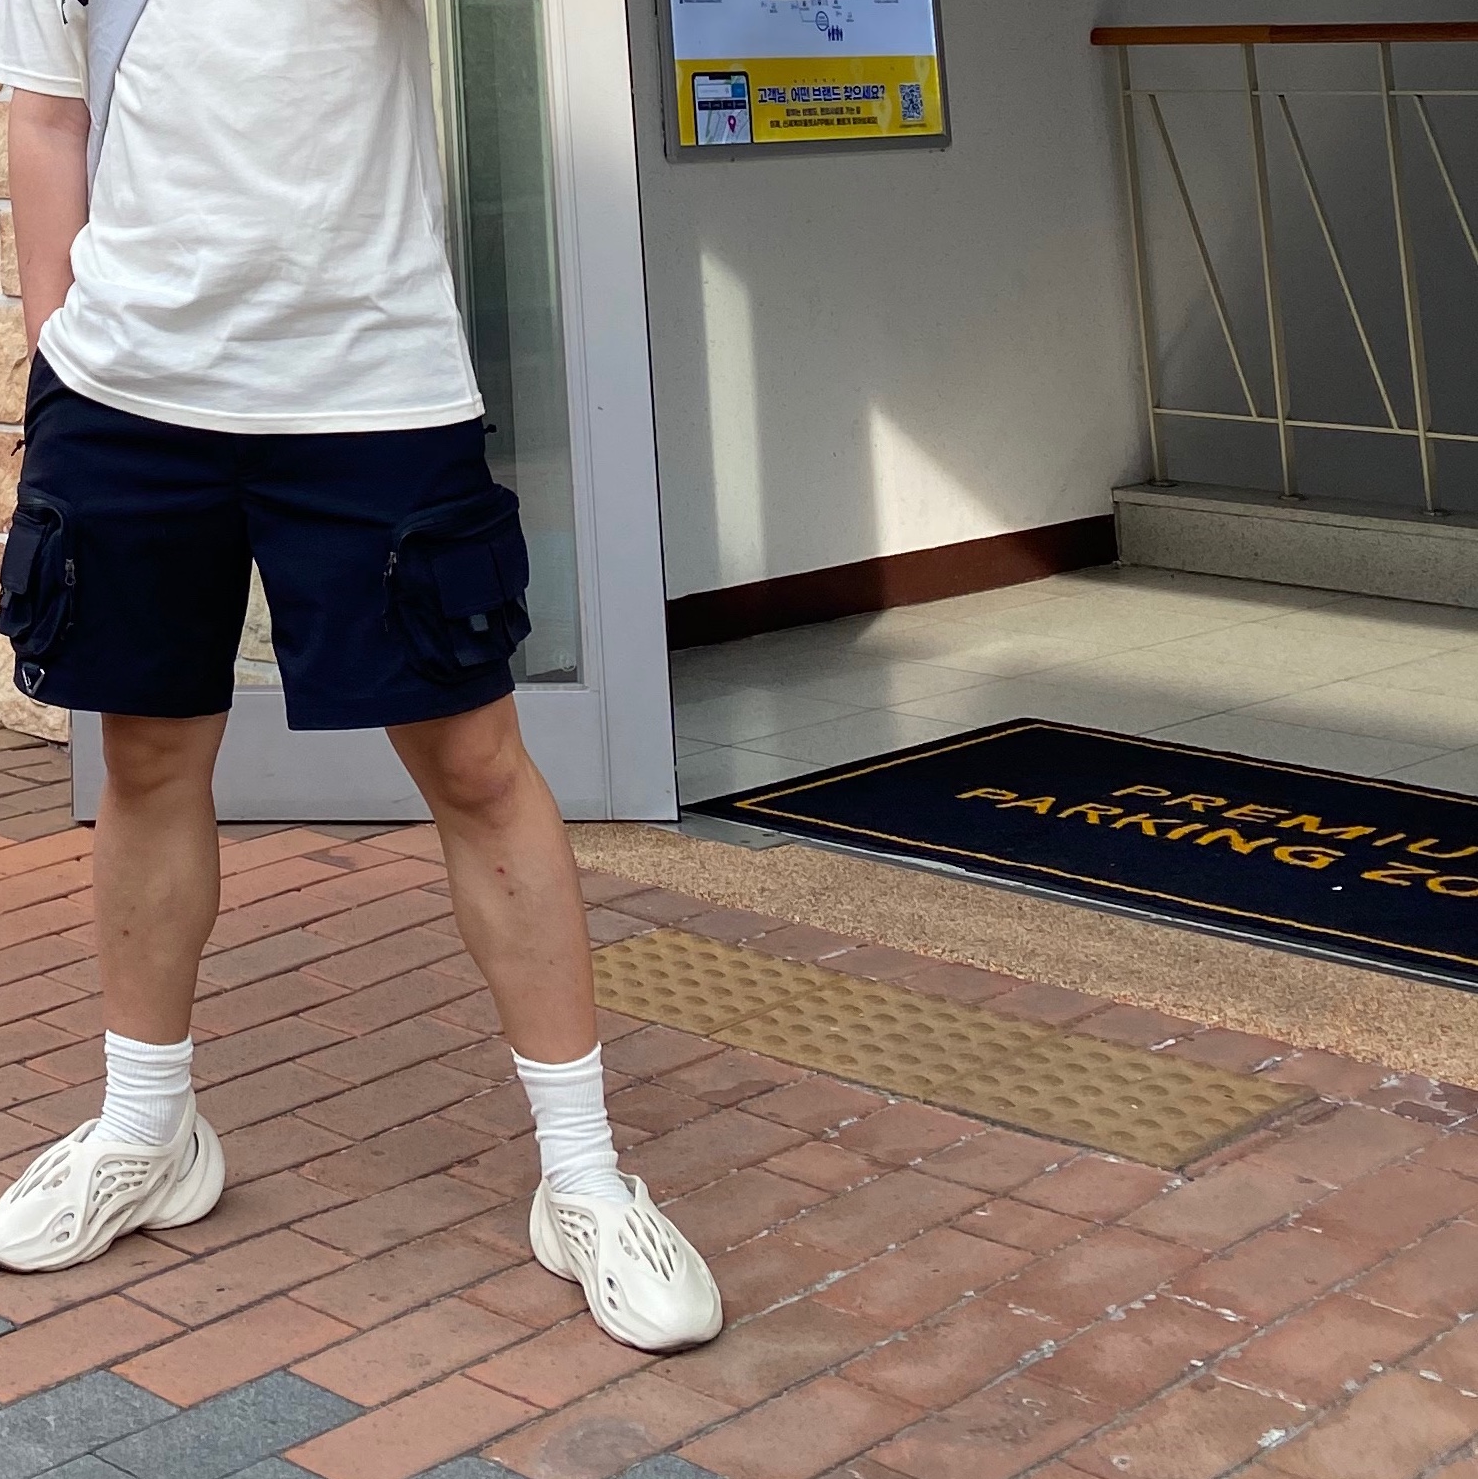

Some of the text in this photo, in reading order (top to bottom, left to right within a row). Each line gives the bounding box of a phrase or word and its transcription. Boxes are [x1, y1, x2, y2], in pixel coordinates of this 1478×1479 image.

[757, 87, 789, 104] 고객님,
[812, 85, 842, 103] 브랜드
[843, 84, 886, 102] 찾으세요?
[955, 787, 1478, 898] PARKING ZO
[1112, 784, 1478, 858] PREMIU
